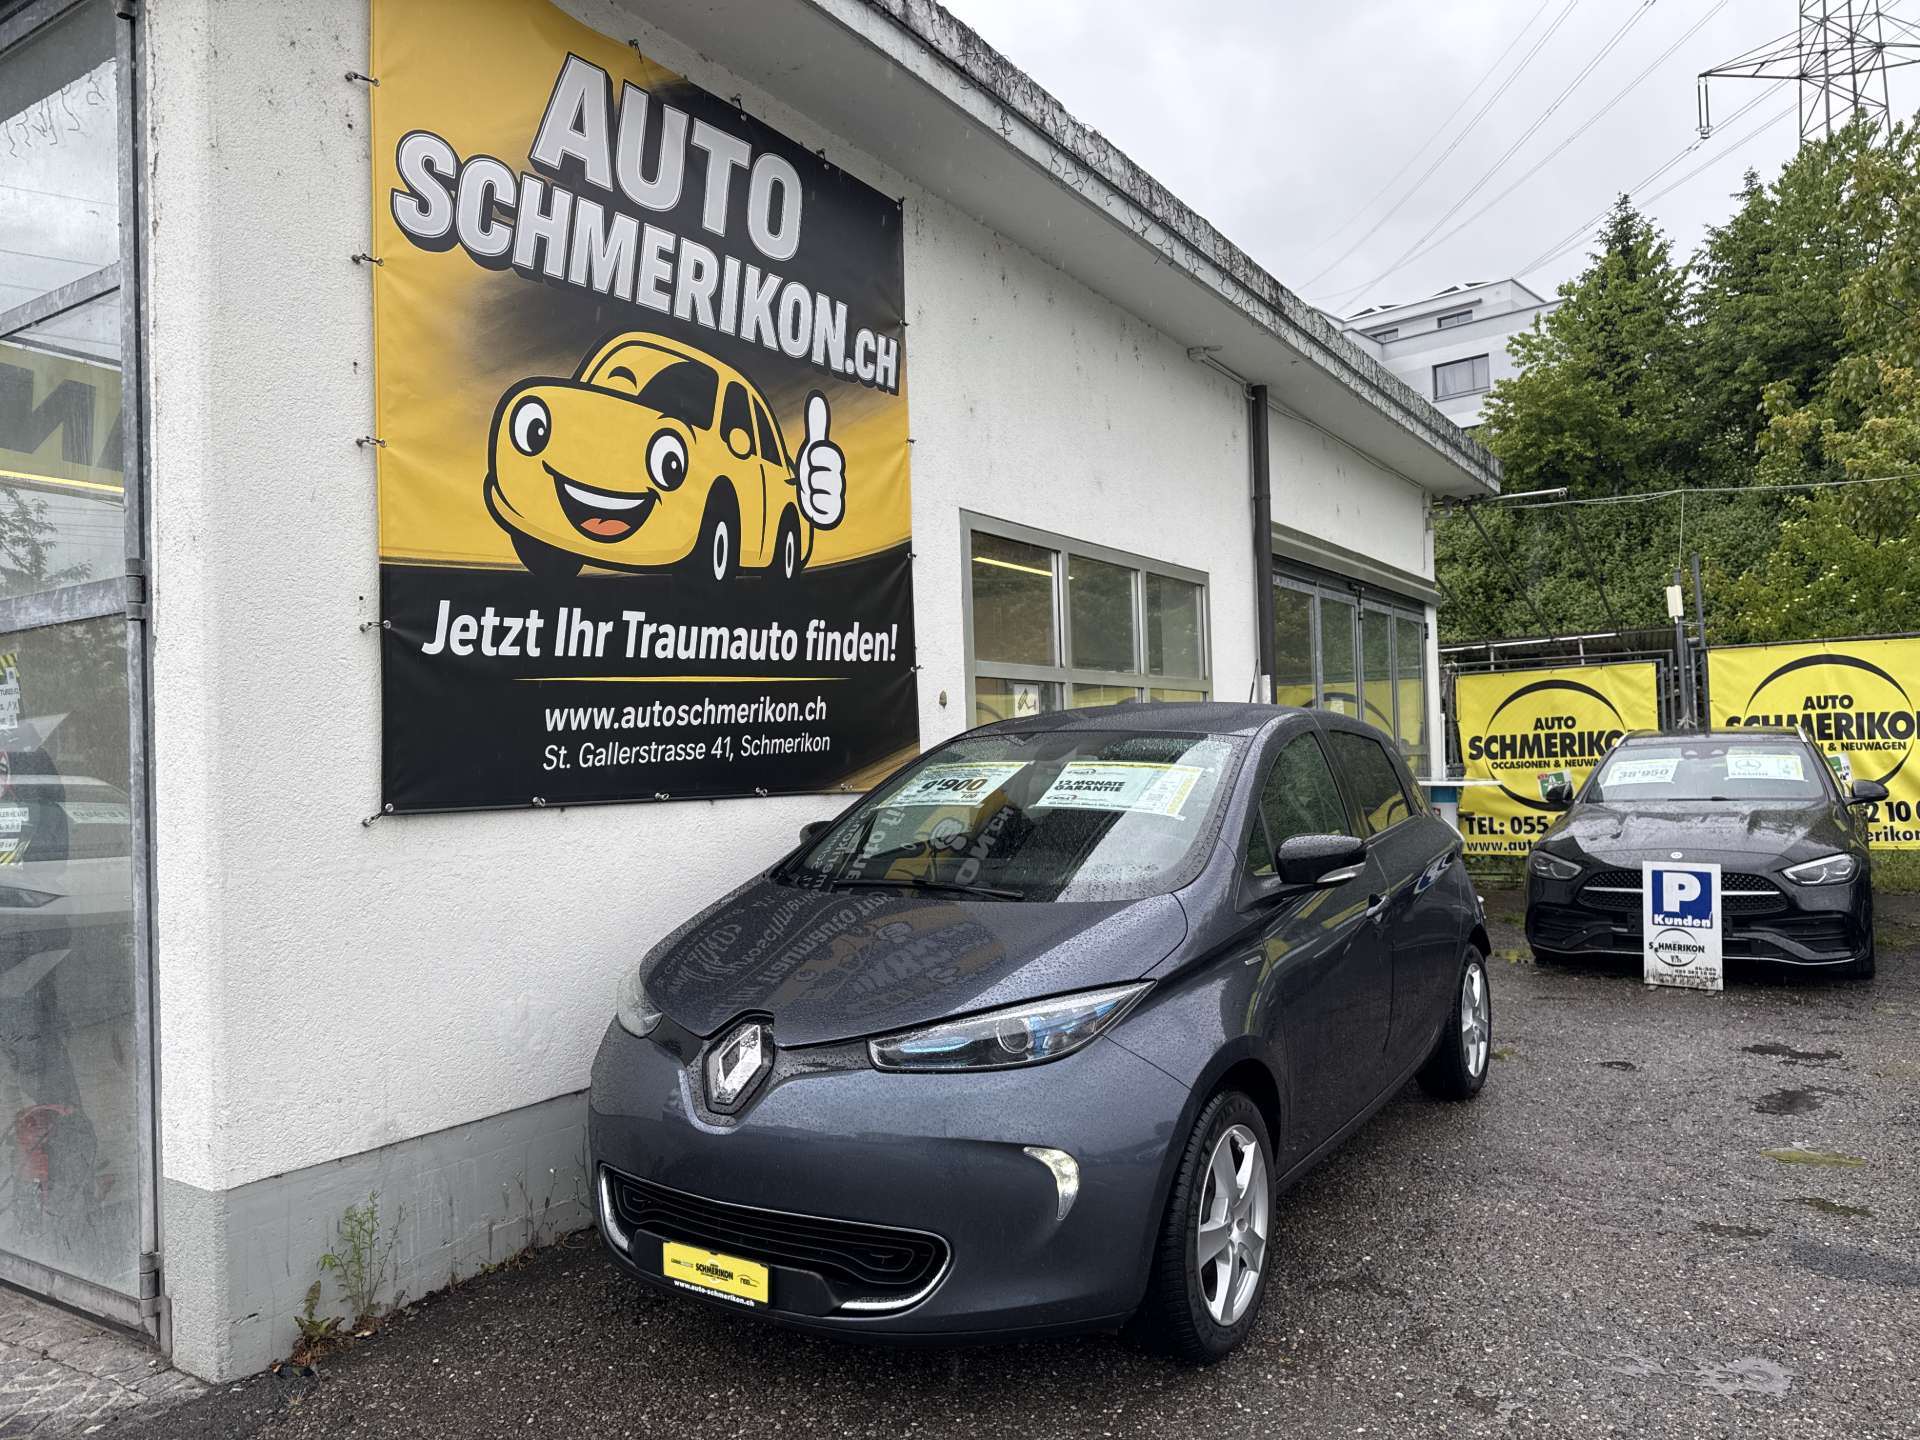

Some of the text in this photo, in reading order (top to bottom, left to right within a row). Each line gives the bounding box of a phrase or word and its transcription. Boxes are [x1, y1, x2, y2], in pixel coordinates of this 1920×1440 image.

[530, 52, 802, 262] AUTO
[392, 131, 899, 390] SCHMERIKON.CH
[421, 599, 898, 663] Jetzt Ihr Traumauto finden!
[1802, 694, 1854, 711] AUTO
[545, 696, 827, 732] www.autoschmerikon.ch
[1533, 715, 1577, 731] AUTO
[543, 734, 831, 771] St. Gallerstrasse 41, Schmerikon
[1468, 729, 1633, 761] SCHMERIKO
[1828, 743, 1837, 751] &
[1841, 741, 1907, 751] NEUWAGEN
[1491, 760, 1551, 769] OCCASIONEN
[1553, 759, 1562, 768] &
[1885, 800, 1911, 822] 10
[1465, 817, 1504, 835] TEL:
[1510, 816, 1549, 835] 055
[1663, 872, 1701, 912] P
[1654, 914, 1711, 928] Kunden
[695, 1263, 734, 1280] SCHMERIKON
